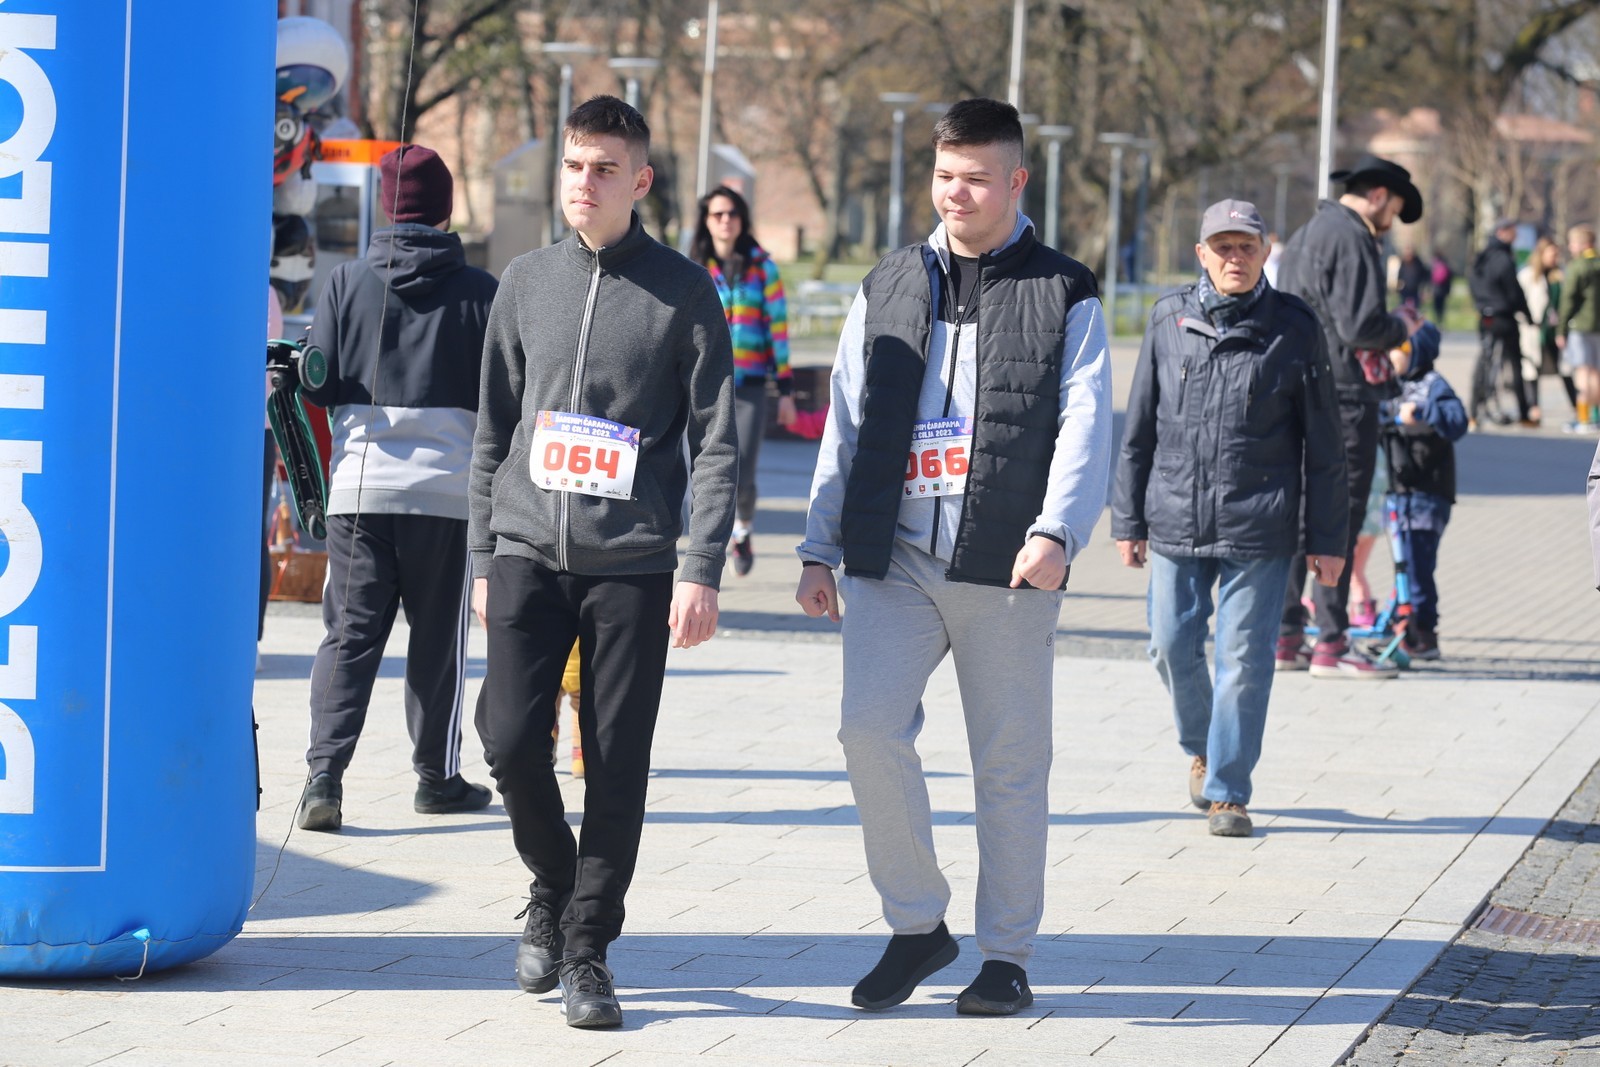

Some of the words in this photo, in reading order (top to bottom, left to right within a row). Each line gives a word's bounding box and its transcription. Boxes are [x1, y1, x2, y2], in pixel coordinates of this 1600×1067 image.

[583, 418, 619, 431] ČARAPAMA
[927, 421, 960, 429] ČARAPAMA
[572, 425, 590, 434] CILJA
[918, 431, 934, 439] CILJA
[543, 441, 620, 479] 064
